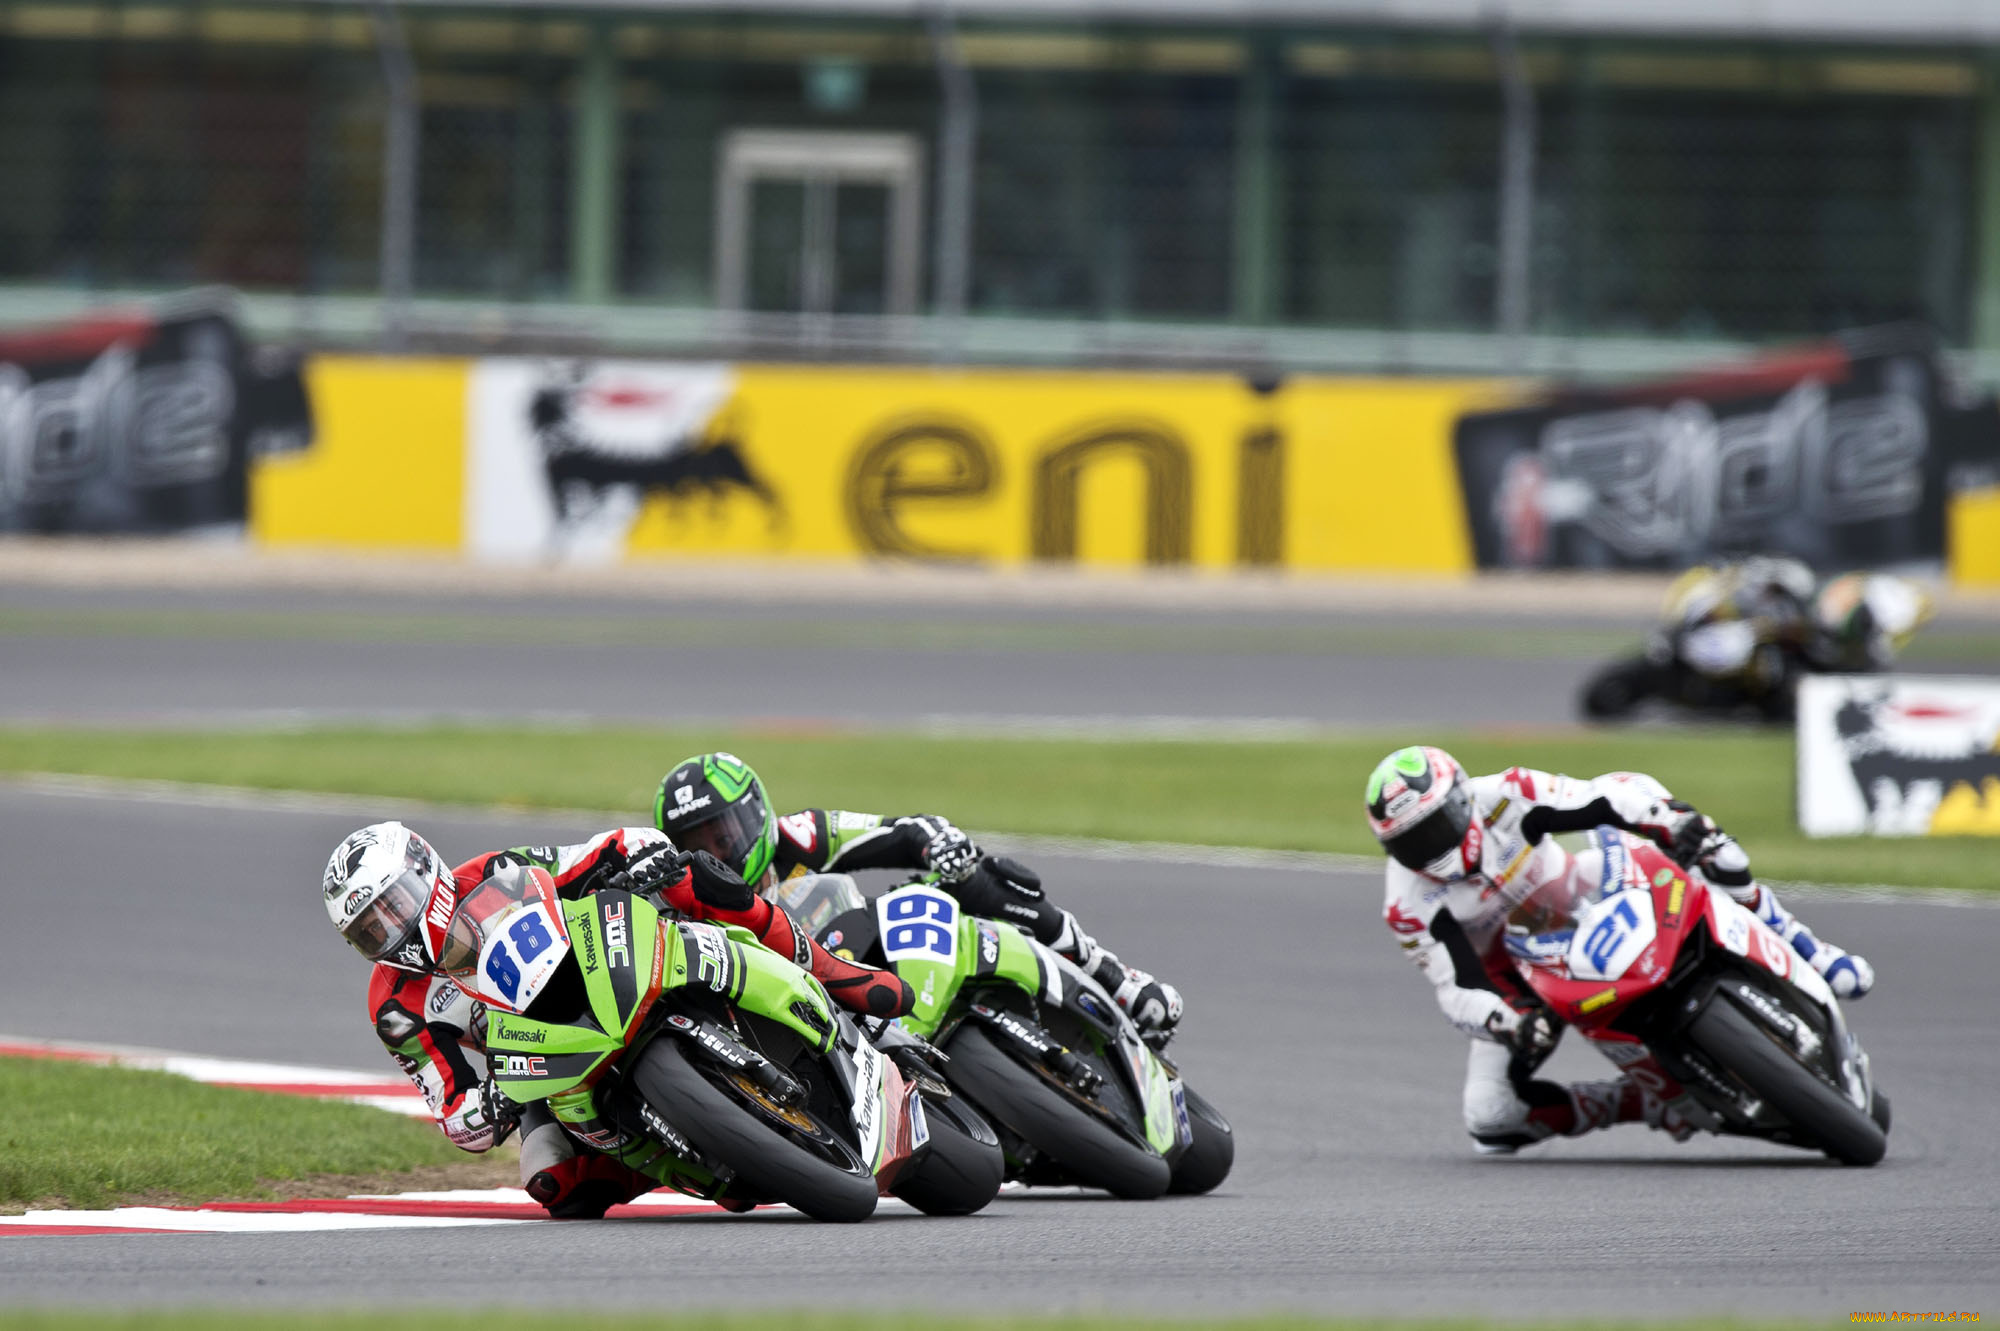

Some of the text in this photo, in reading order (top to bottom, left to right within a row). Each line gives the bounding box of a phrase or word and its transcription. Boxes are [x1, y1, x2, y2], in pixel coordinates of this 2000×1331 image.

[841, 372, 1288, 567] eni
[667, 793, 712, 821] SHARK
[346, 886, 373, 915] Airoh
[427, 884, 456, 930] WILD
[886, 893, 953, 957] 99
[485, 911, 553, 1005] 88
[576, 911, 599, 975] Kawasaki
[1583, 898, 1640, 975] 21
[497, 1025, 547, 1043] Kawasaki
